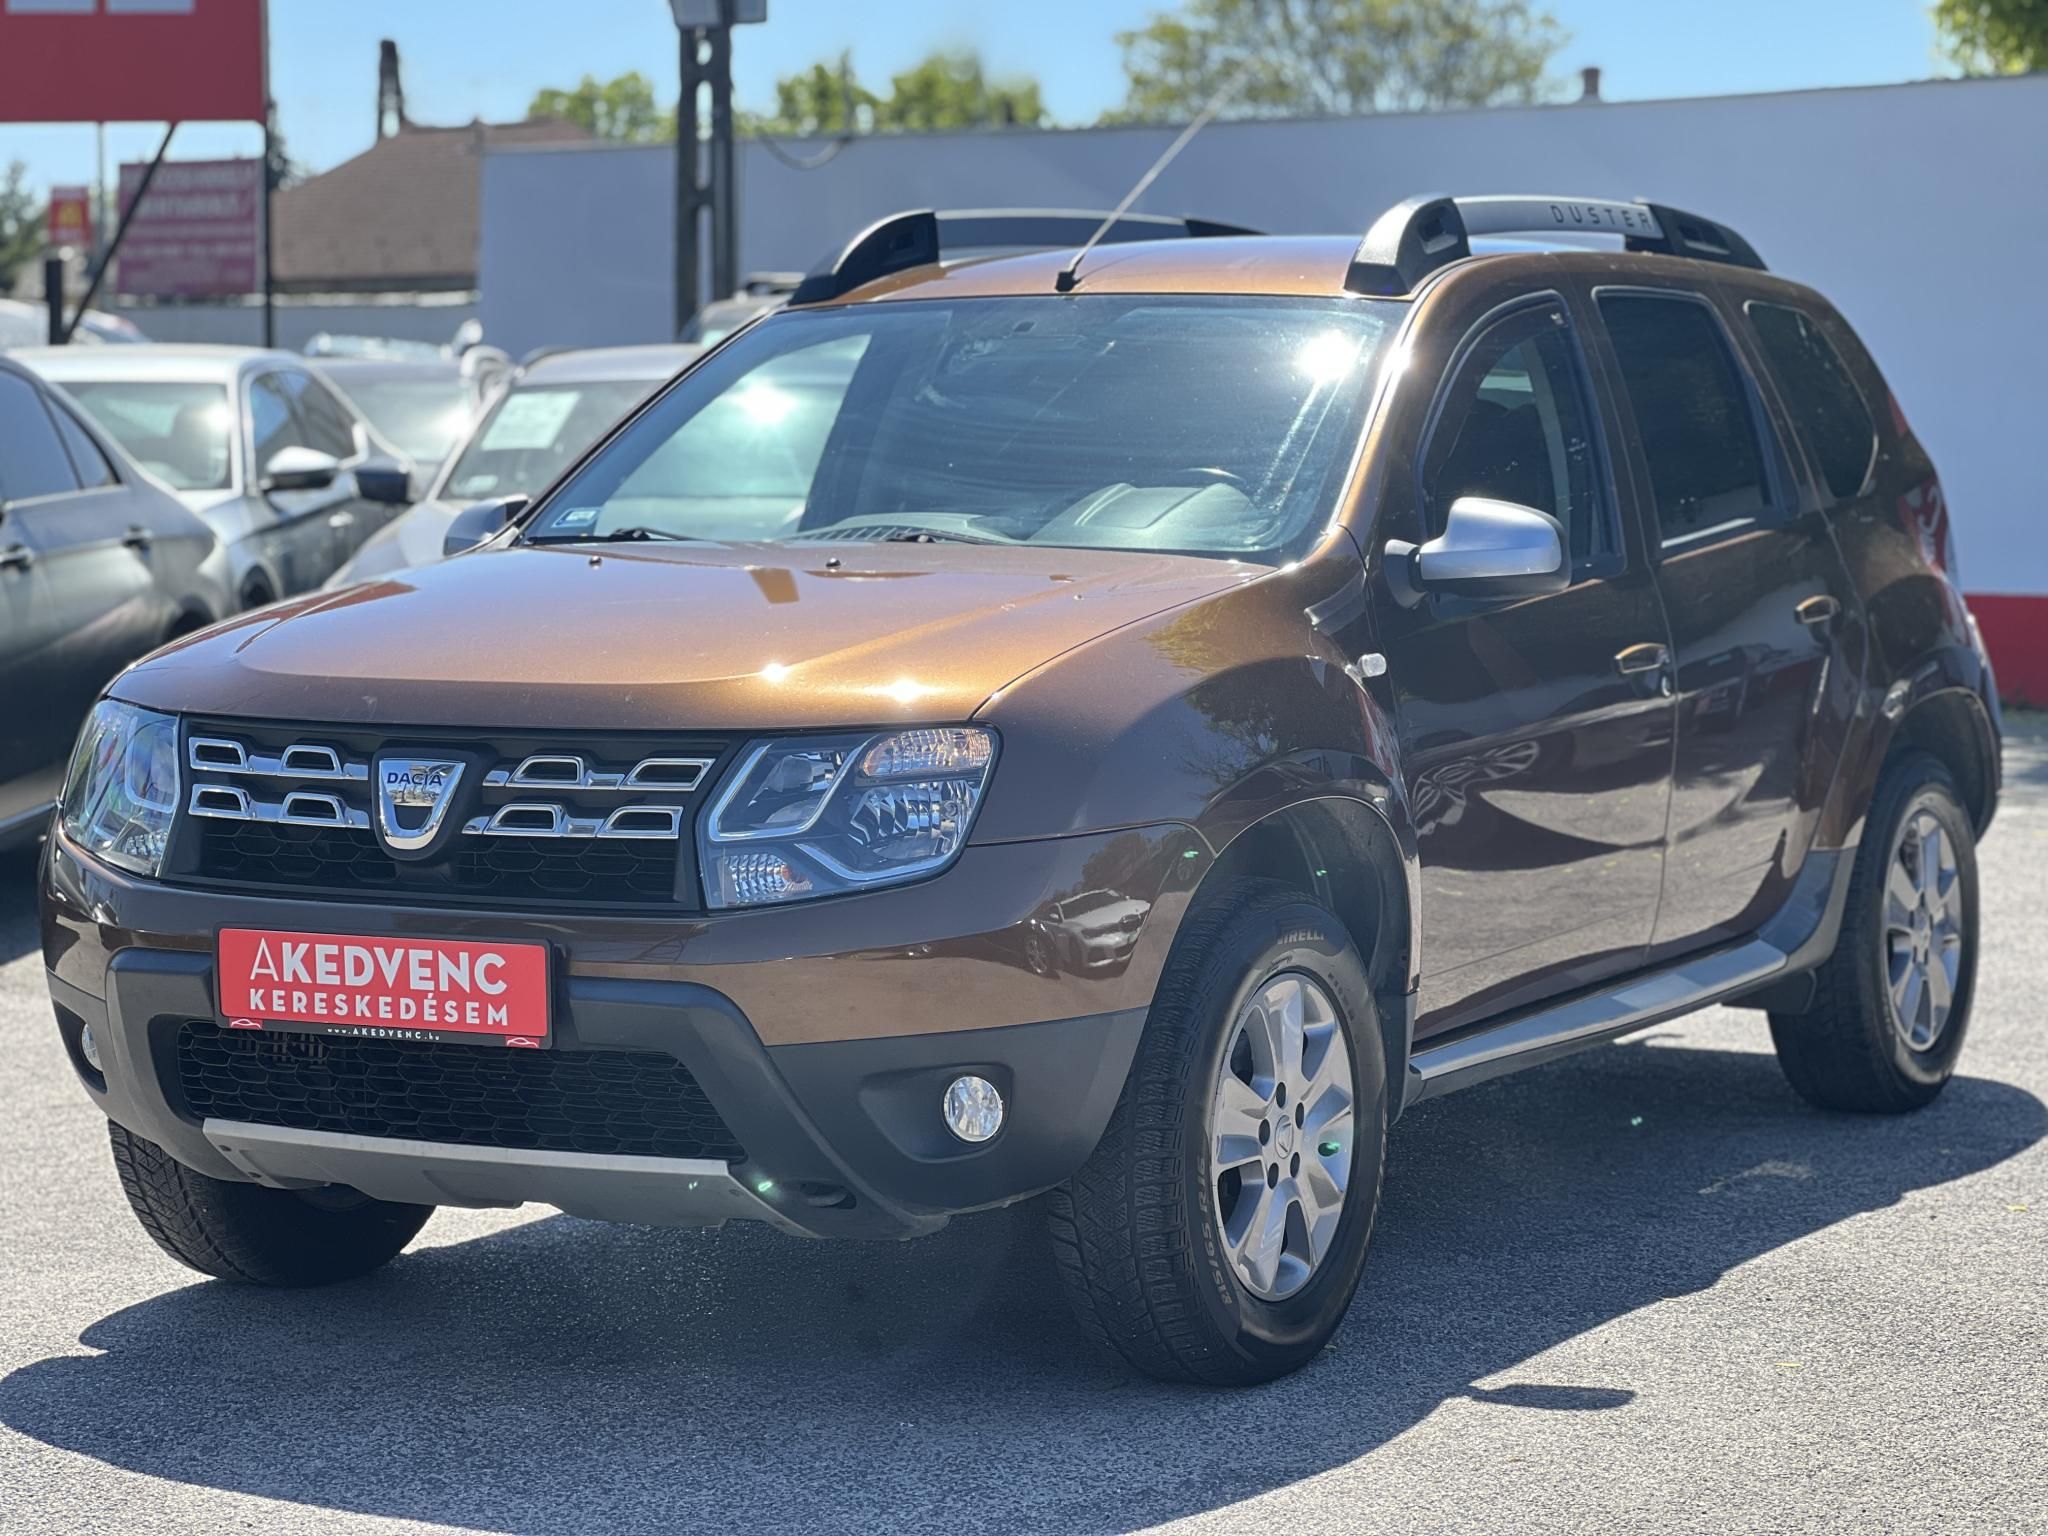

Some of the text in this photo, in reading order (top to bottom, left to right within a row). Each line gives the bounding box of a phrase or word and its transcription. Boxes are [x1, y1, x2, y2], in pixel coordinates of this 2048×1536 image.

[1551, 205, 1652, 230] DUSTER
[387, 772, 442, 786] DACIA
[250, 937, 507, 995] AKEDVENC
[250, 989, 508, 1026] KERESKEDÉSEM
